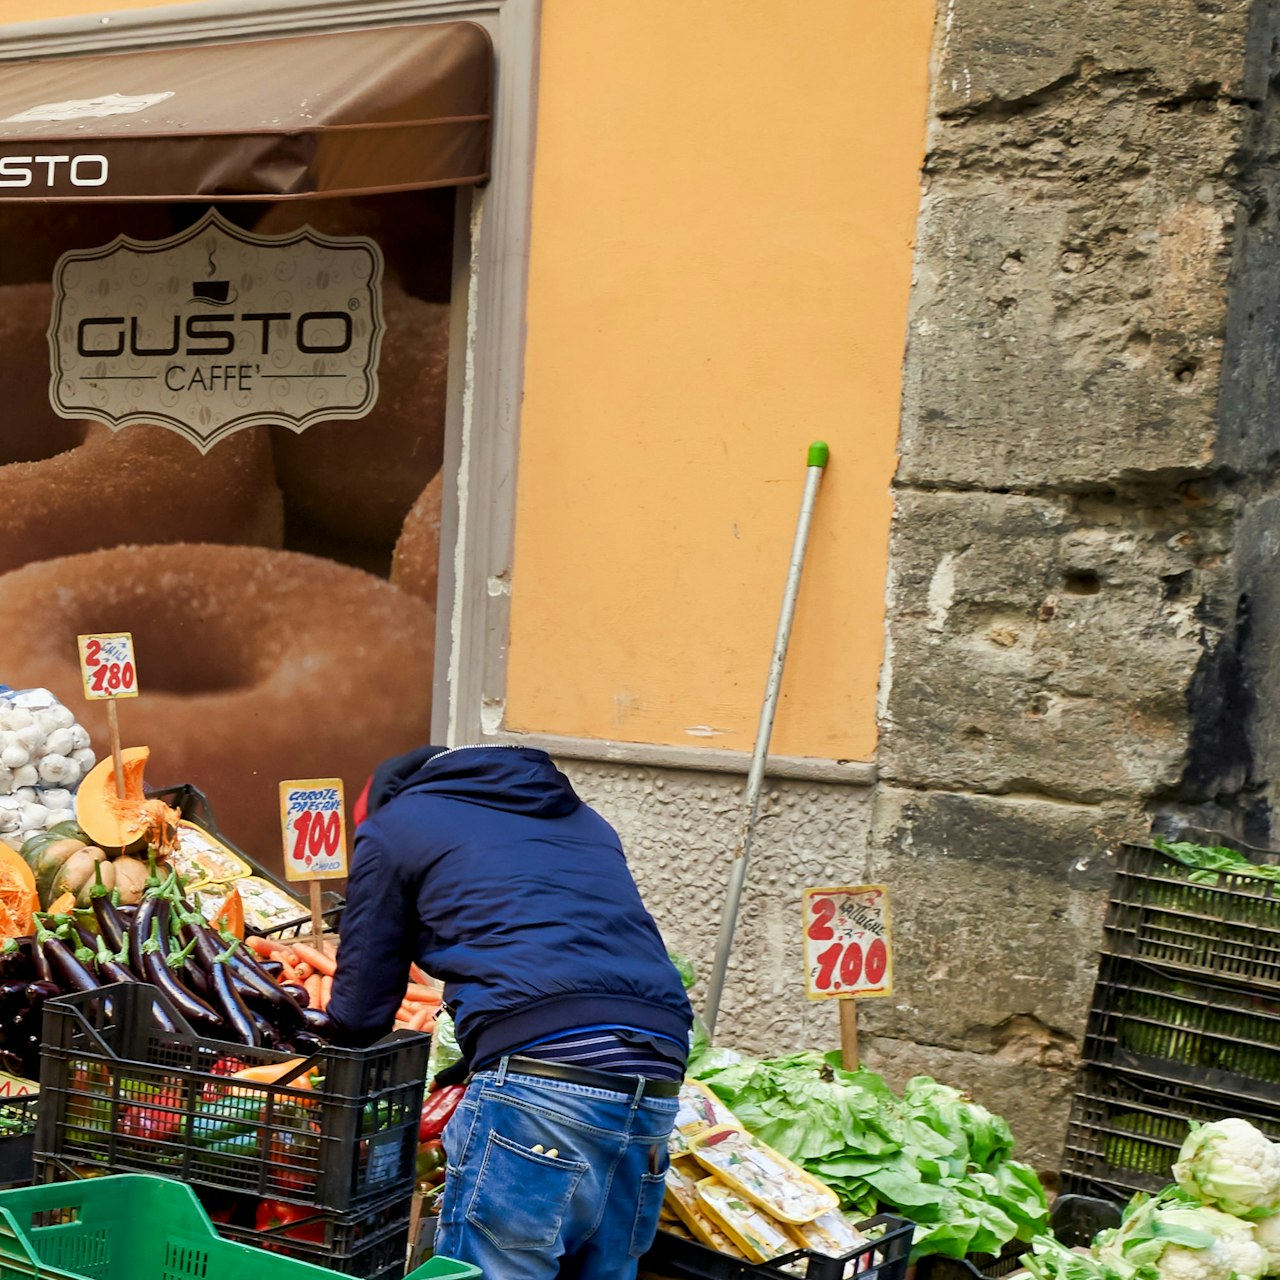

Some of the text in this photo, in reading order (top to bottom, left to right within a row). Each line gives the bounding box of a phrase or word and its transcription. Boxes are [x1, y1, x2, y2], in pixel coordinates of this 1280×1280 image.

[77, 312, 352, 358] GUSTO
[86, 640, 102, 667] 2
[289, 788, 338, 801] CAROTE
[808, 898, 836, 940] 2
